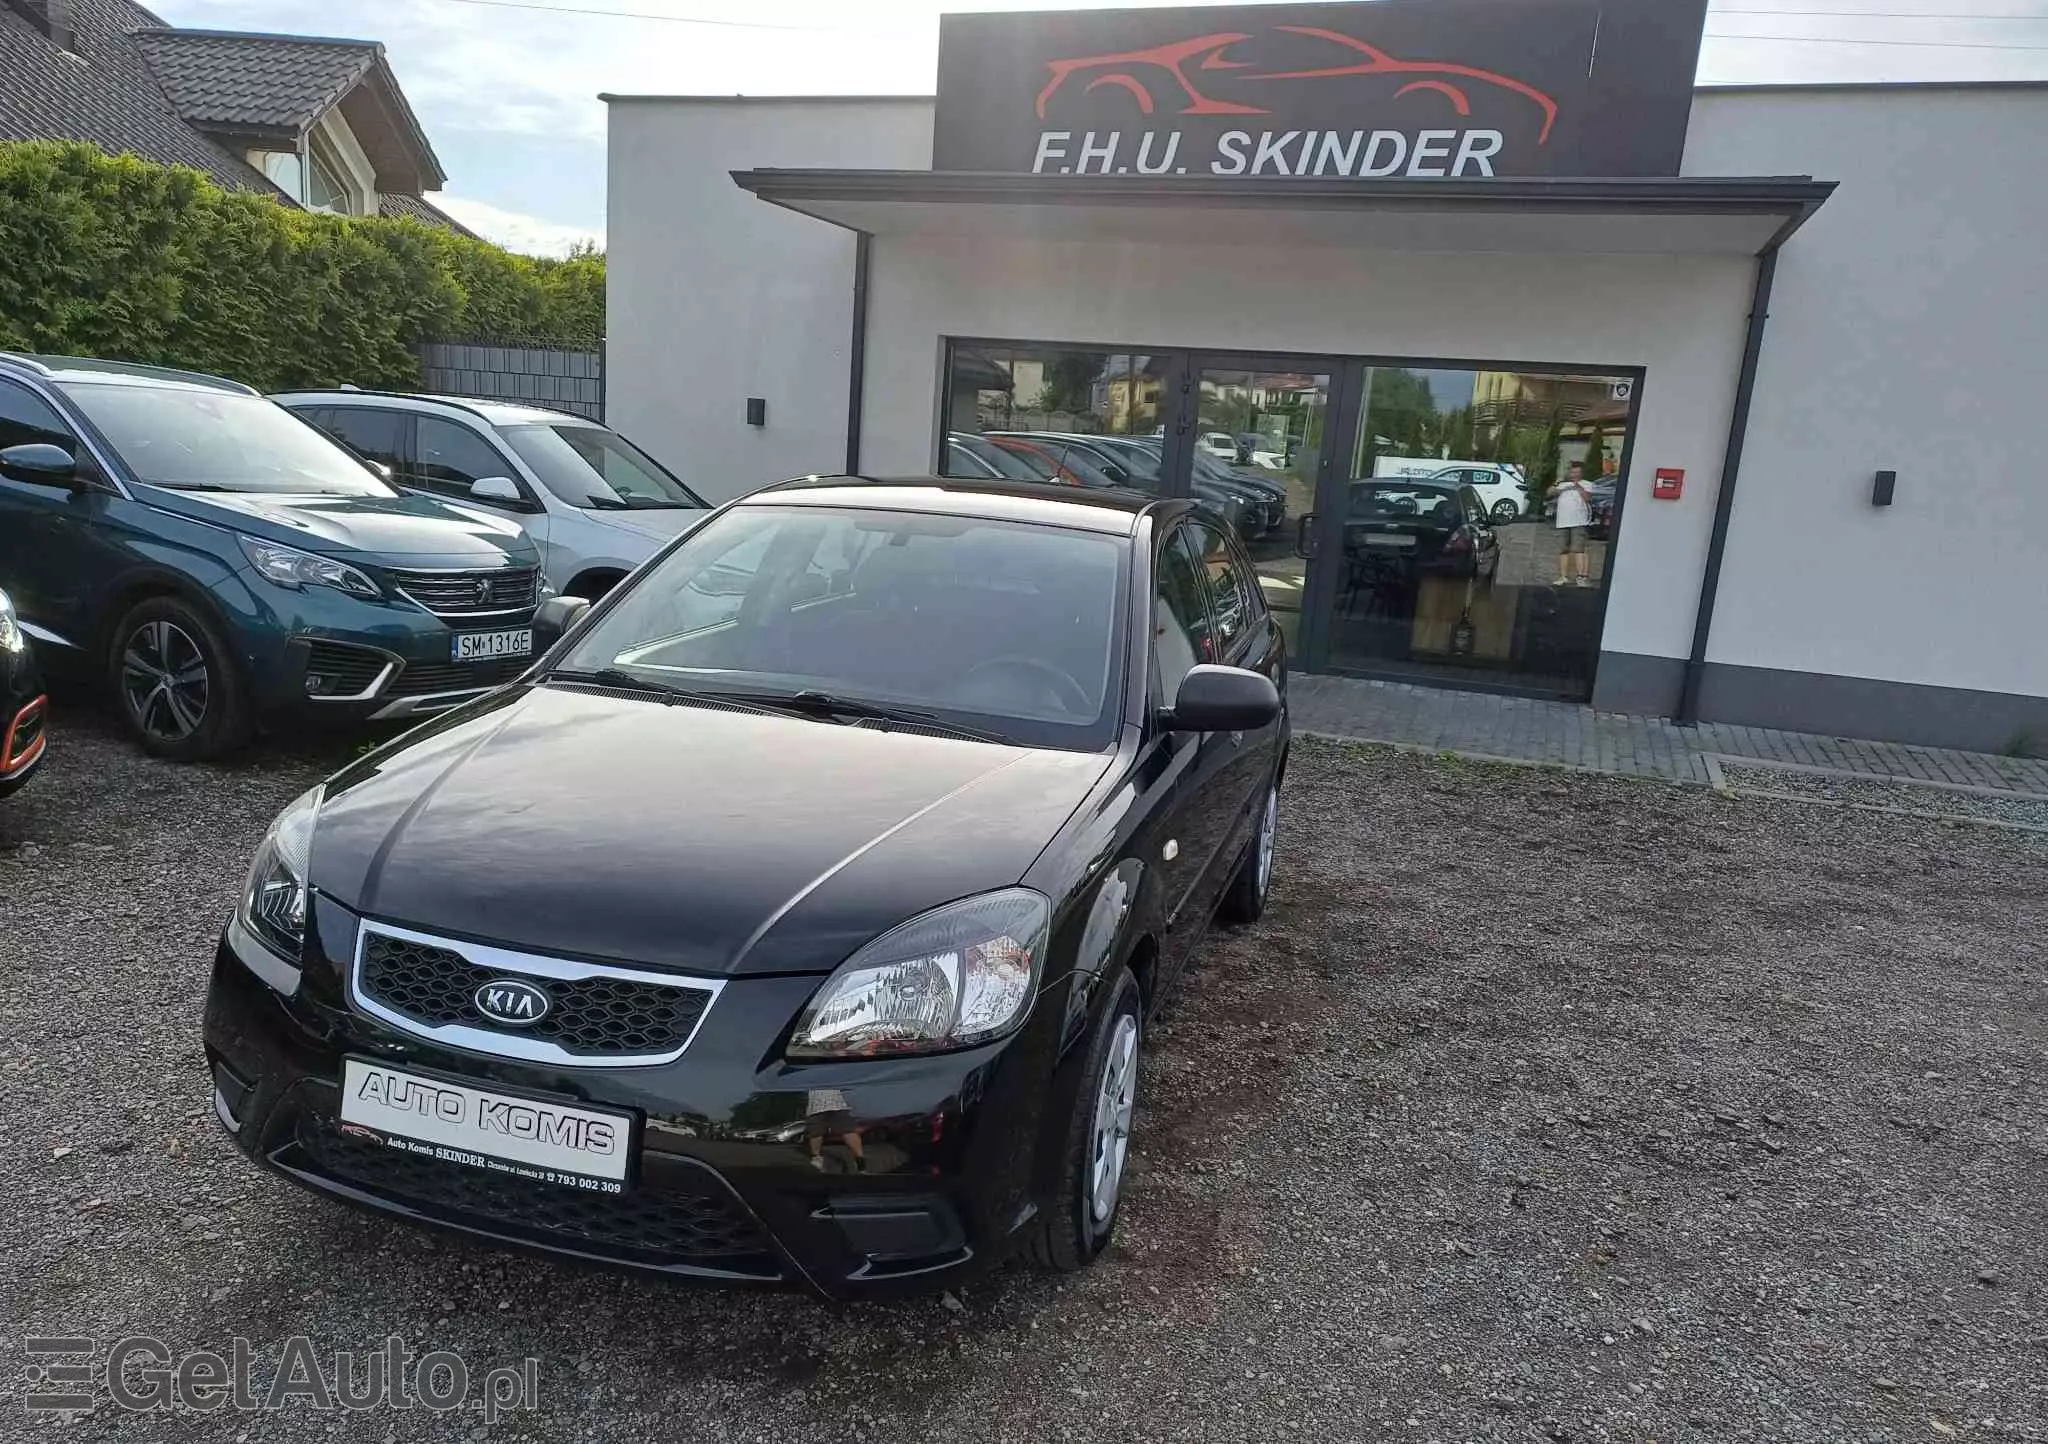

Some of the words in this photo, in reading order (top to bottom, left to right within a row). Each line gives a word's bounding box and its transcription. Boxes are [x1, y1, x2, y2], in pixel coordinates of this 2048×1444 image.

[1031, 131, 1186, 175] F.H.U.
[1210, 129, 1504, 177] SKINDER
[462, 635, 481, 656] SM
[488, 631, 529, 653] 1316E
[486, 988, 533, 1018] KIA
[358, 1071, 466, 1124] AUTO
[478, 1097, 616, 1156] KOMIS
[387, 1137, 407, 1150] Auto
[408, 1141, 434, 1155] Komis
[435, 1147, 485, 1168] SKINDER
[557, 1174, 577, 1187] 793
[579, 1178, 599, 1190] 002
[600, 1182, 621, 1194] 309
